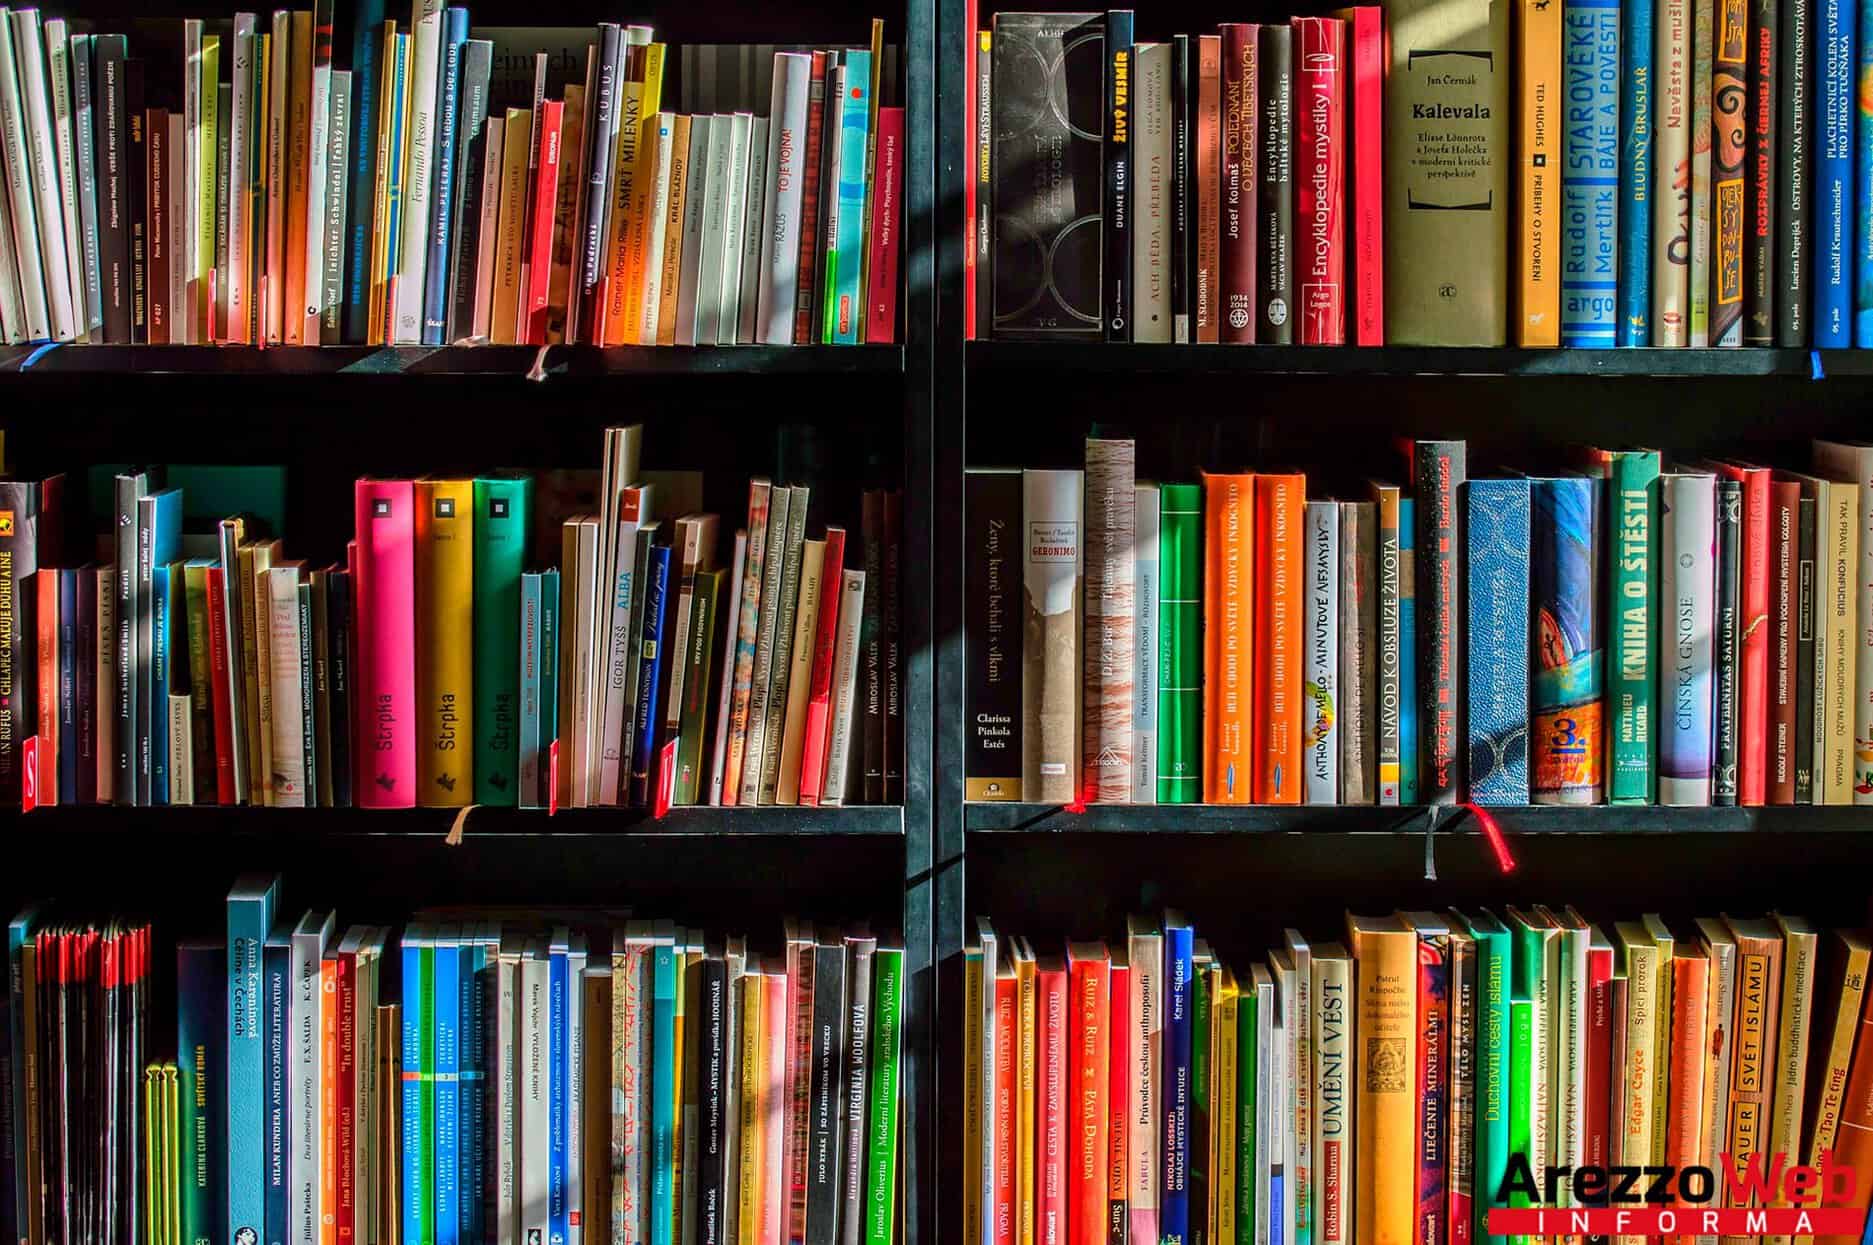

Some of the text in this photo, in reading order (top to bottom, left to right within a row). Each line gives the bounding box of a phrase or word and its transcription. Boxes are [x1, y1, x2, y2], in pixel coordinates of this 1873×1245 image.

[446, 71, 455, 90] bez
[448, 43, 457, 67] teba
[1427, 74, 1477, 87] Jan Čermák
[1826, 0, 1838, 159] PLACHETNICÍ KOLEM SVĚTA
[599, 64, 613, 121] KUBUS
[1412, 103, 1491, 120] Kalevala
[1537, 83, 1546, 102] TED
[1566, 14, 1594, 169] STAROVĚKÉ
[1598, 13, 1617, 169] BÁJE A POVĚSTI
[1838, 36, 1849, 159] PRO PÍRKO TUČŇÁKA
[443, 104, 453, 136] tebou
[780, 128, 792, 163] VOJNA!
[1114, 52, 1128, 228] DUANE ELGIN ŽIVÝ VESMÍR
[1267, 99, 1277, 182] Encyklopedie
[1279, 73, 1289, 182] baltské mytologie
[1446, 133, 1486, 143] Lönnrota
[1536, 106, 1546, 147] HUGHES
[1633, 66, 1647, 201] BLUDNÝ BRUSLAŘ
[1755, 27, 1770, 236] ROZPRÁVKY Z ČIERNEJ AFRIKY
[412, 112, 427, 203] Fernando Pessoa
[616, 96, 639, 209] SMRŤ MILENKY
[779, 167, 792, 177] JE
[1227, 81, 1240, 239] Josef Kolmaš POJEDNÁNÍ
[1242, 123, 1254, 177] VĚCECH
[1419, 156, 1492, 166] moderní kritické
[1423, 144, 1487, 154] Josefa Holečka
[329, 169, 341, 225] Schwindel
[439, 159, 449, 205] PETERAJ
[778, 179, 788, 193] TO
[1243, 181, 1253, 191] O
[1313, 94, 1330, 276] Encyklopedie mystiky
[327, 230, 339, 272] leichter
[436, 211, 446, 245] KAMIL
[1149, 155, 1162, 302] ACH BĚDA, PŘEBĚDA
[1534, 219, 1542, 227] O
[1566, 190, 1585, 273] Rudolf
[1595, 191, 1612, 273] Mertlík
[1832, 180, 1843, 284] Rudolf Krautschneider
[1567, 296, 1614, 320] argo
[1032, 546, 1075, 556] GERONIMO
[1838, 500, 1849, 617] TAK PRAVIL KONFUCIUS
[617, 572, 631, 610] ALBA
[1619, 490, 1647, 680] KNIHA O ŠTĚSTÍ
[1382, 538, 1397, 738] NÁVOD K OBSLUZE ŽIVOTA
[1677, 597, 1693, 730] ČÍNSKÁ GNOSE
[612, 659, 625, 689] IGOR
[1721, 608, 1732, 749] FRATERNITAS SATURNI
[376, 695, 397, 751] Štrpka
[435, 694, 459, 751] Štrpka
[489, 694, 511, 751] Štrpka
[977, 714, 1011, 723] Clarissa
[977, 727, 1010, 737] Pinkola
[983, 739, 1005, 749] Estés
[235, 938, 246, 974] Céline
[1636, 956, 1648, 993] prorok
[235, 988, 247, 1036] Čechách
[247, 938, 259, 1040] Anna Kareninová
[1172, 958, 1184, 1020] Karel Sládek
[1461, 984, 1471, 1078] TĚLO MYSL ZEN
[1484, 955, 1504, 1121] Duchovní cesty islámu
[1742, 960, 1763, 1085] SVĚT ISLÁMU
[1785, 950, 1806, 1086] Jádro buddhistické meditace
[274, 1066, 281, 1079] CO
[850, 1004, 865, 1120] VIRGINIA WOOLFOVÁ
[1138, 975, 1152, 1125] Průvodce českou anthroposofií
[1318, 980, 1343, 1135] UMĚNÍ VÉST
[1632, 1049, 1645, 1090] Cayce
[273, 1081, 281, 1105] ANEB
[875, 972, 895, 1239] Jaroslav Oliverius Moderní literatury arabského Východu
[1424, 1010, 1438, 1161] LIEČENIE MINERÁLMI
[273, 1108, 281, 1153] KUNDERA
[1631, 1095, 1645, 1135] Edgar
[273, 1155, 281, 1185] MILAN
[1327, 1145, 1338, 1236] Robin S. Sharma
